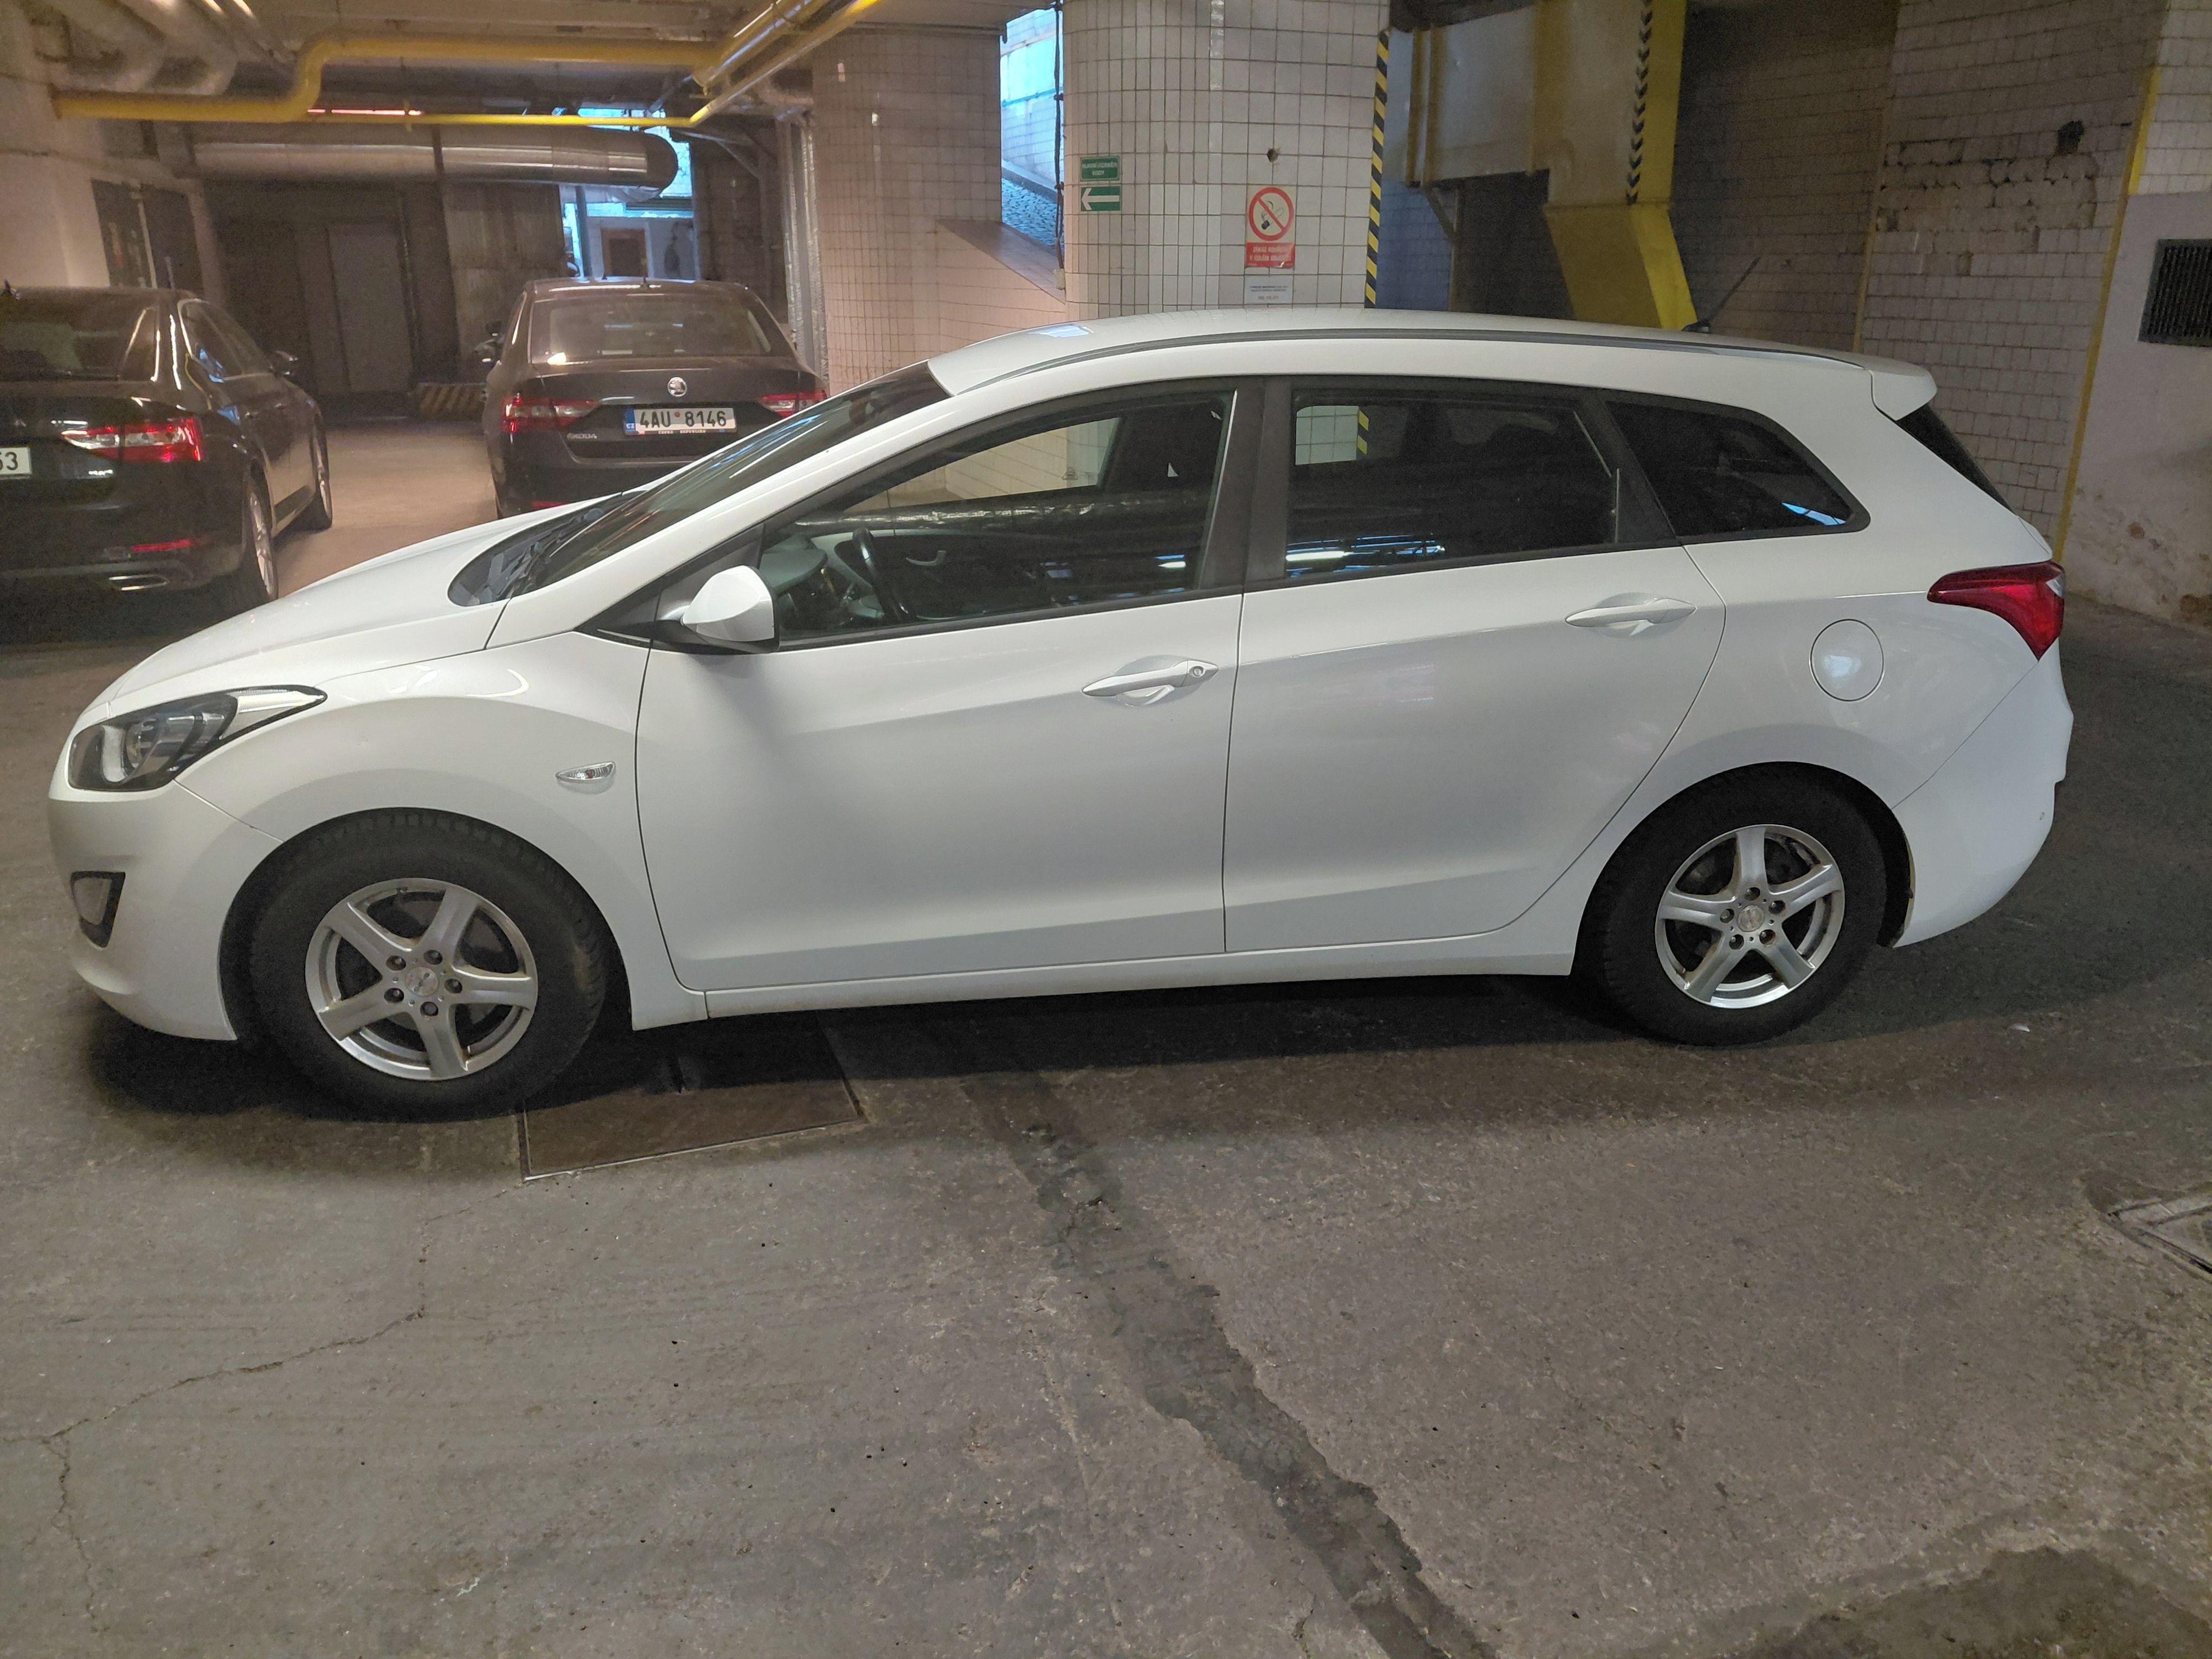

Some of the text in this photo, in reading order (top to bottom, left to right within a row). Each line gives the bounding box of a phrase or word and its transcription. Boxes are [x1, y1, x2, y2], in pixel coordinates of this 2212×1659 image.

[640, 410, 726, 428] 4AU 8146
[0, 452, 18, 471] 3
